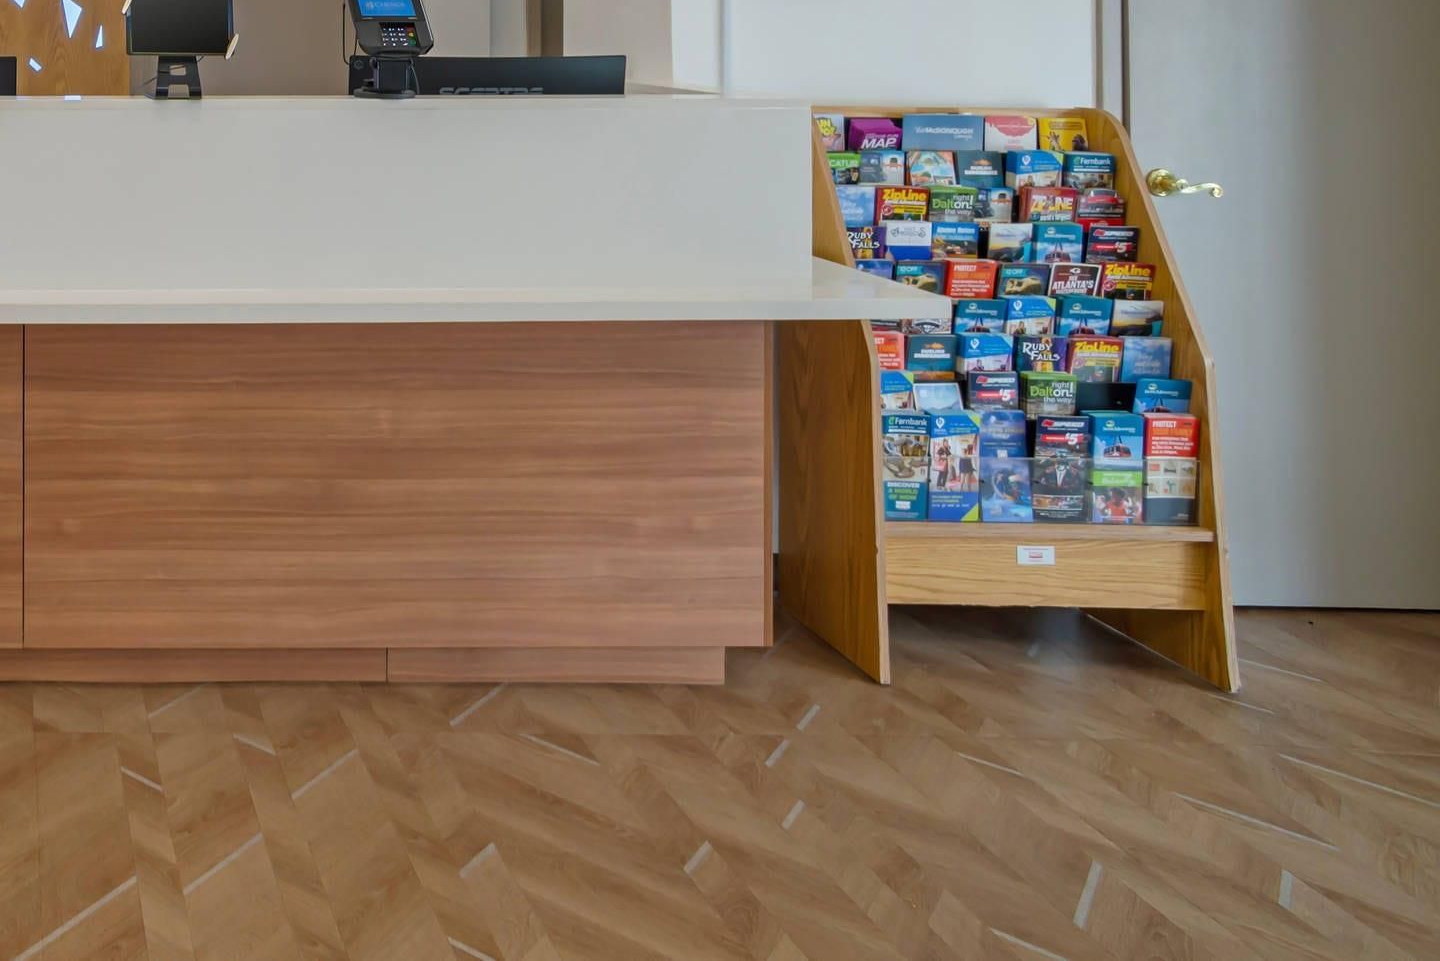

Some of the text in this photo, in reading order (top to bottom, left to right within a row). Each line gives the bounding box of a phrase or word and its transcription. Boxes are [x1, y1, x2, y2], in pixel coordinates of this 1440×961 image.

[861, 138, 898, 149] MAP
[852, 239, 880, 249] FALLS
[1105, 264, 1151, 276] ZipLine
[1052, 279, 1094, 290] ATLANTA'S
[1023, 341, 1053, 355] RUBY
[1030, 350, 1060, 361] FALLS
[895, 417, 928, 426] Fernbank
